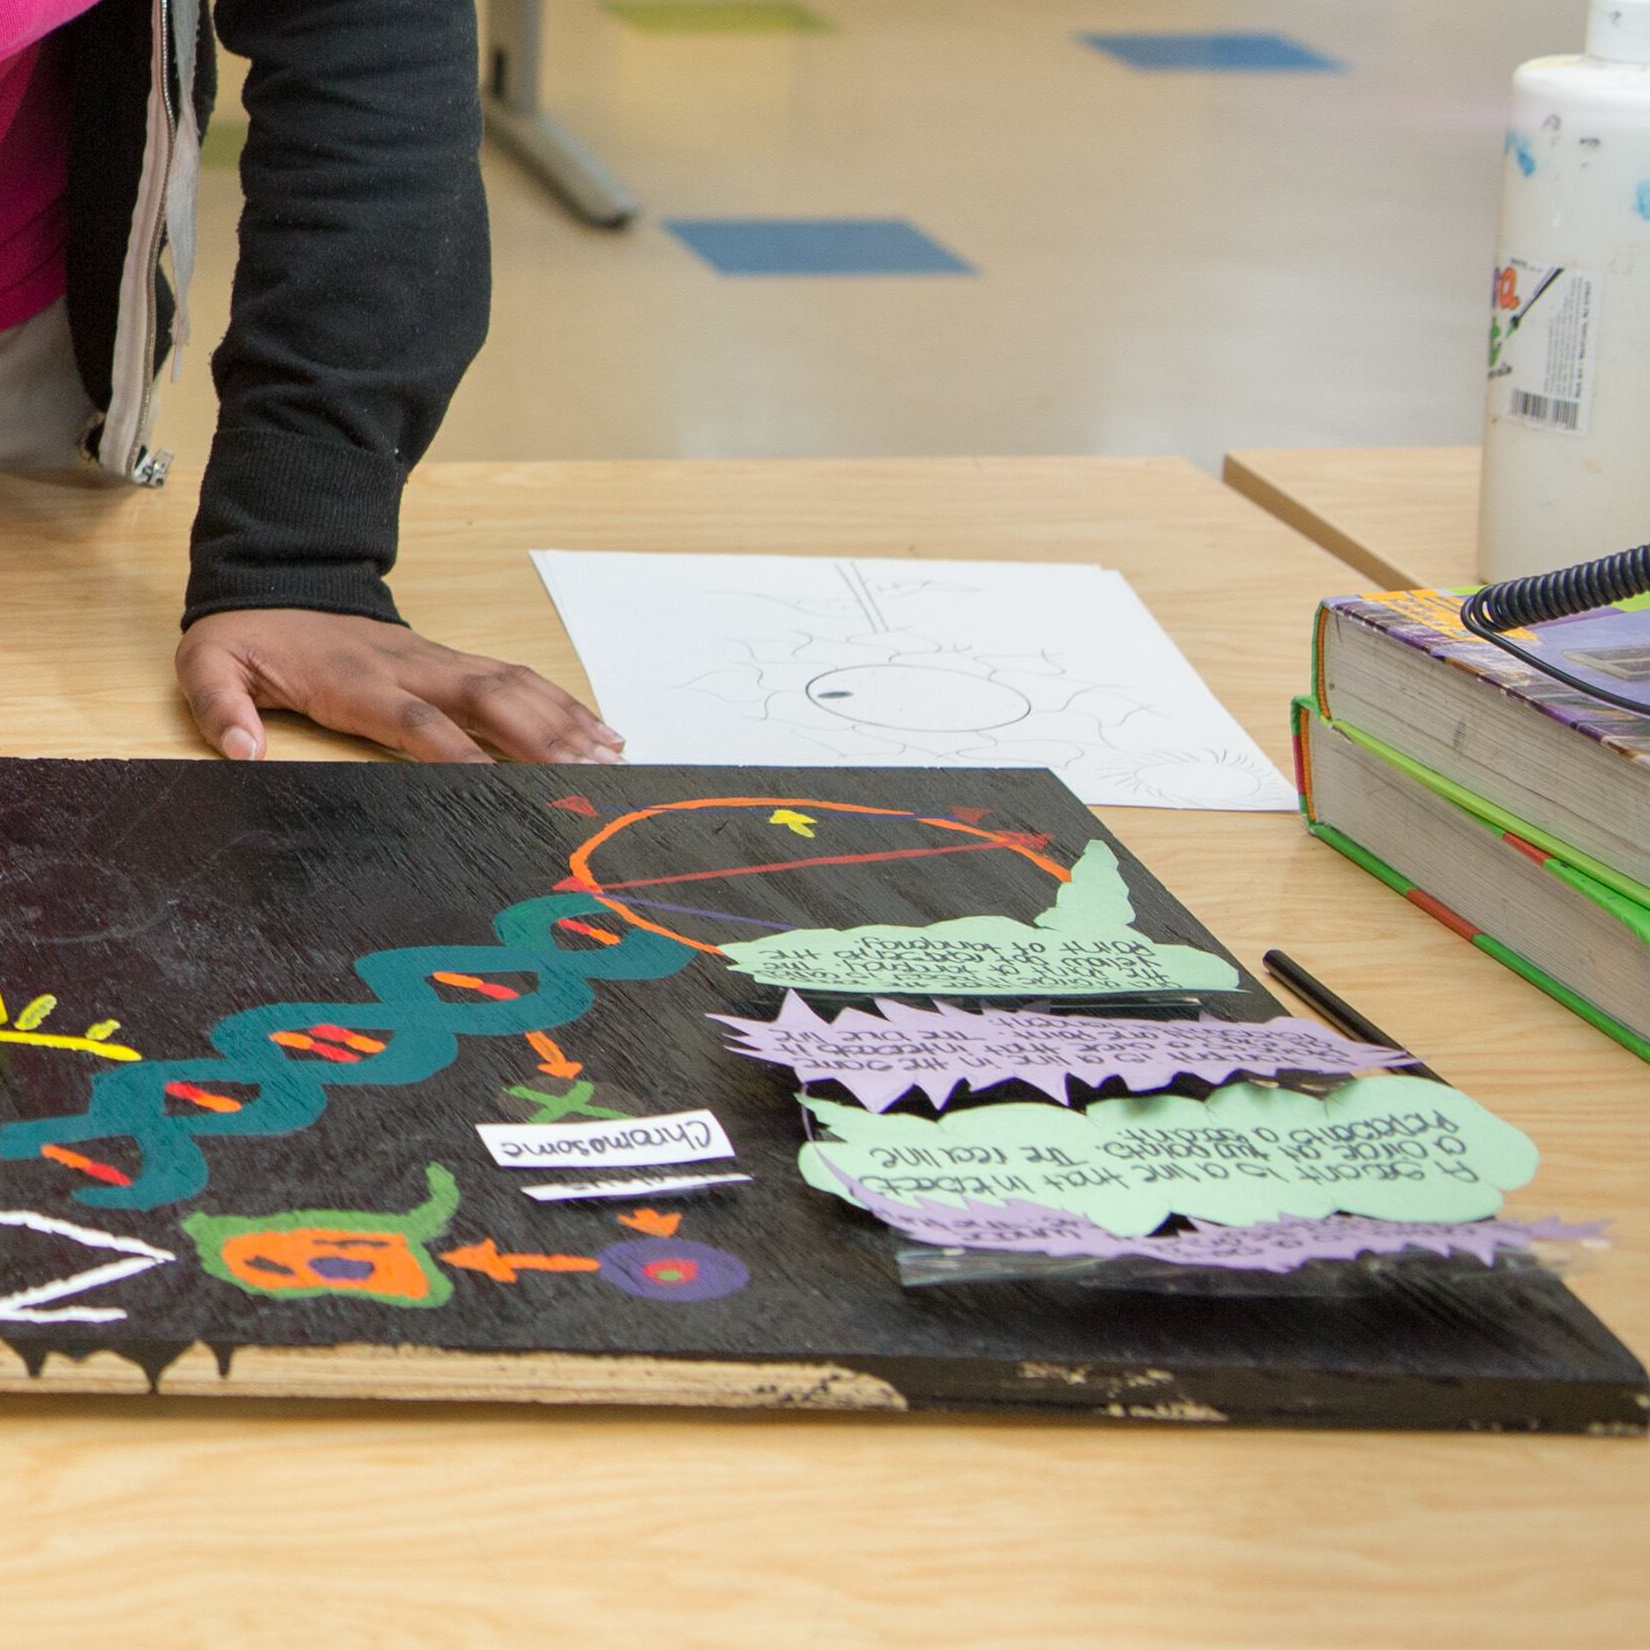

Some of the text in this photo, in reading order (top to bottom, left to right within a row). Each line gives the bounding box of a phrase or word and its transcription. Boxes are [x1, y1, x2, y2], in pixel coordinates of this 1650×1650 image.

[758, 948, 822, 961] the
[1011, 941, 1046, 957] of
[987, 964, 1020, 977] of
[1030, 965, 1110, 981] point
[1118, 967, 1171, 984] the
[767, 1027, 829, 1045] line
[836, 1030, 913, 1043] blue
[916, 1030, 987, 1042] The
[1096, 1030, 1160, 1041] one
[982, 1042, 1062, 1058] that
[792, 1057, 893, 1072] same
[897, 1056, 950, 1072] the
[957, 1056, 1002, 1071] in
[1007, 1054, 1072, 1068] line
[1075, 1054, 1105, 1066] a
[500, 1119, 711, 1159] Chromosome
[1251, 1127, 1280, 1143] a
[1213, 1140, 1270, 1163] two
[1331, 1140, 1429, 1162] circle
[1432, 1134, 1467, 1157] a
[868, 1146, 943, 1170] line
[937, 1146, 1008, 1167] red
[1018, 1145, 1090, 1168] The
[1276, 1144, 1322, 1165] at
[1042, 1167, 1131, 1193] that
[1130, 1162, 1202, 1184] line
[1194, 1162, 1230, 1181] a
[1235, 1162, 1291, 1184] is
[1298, 1160, 1426, 1187] secant
[1432, 1160, 1480, 1184] A
